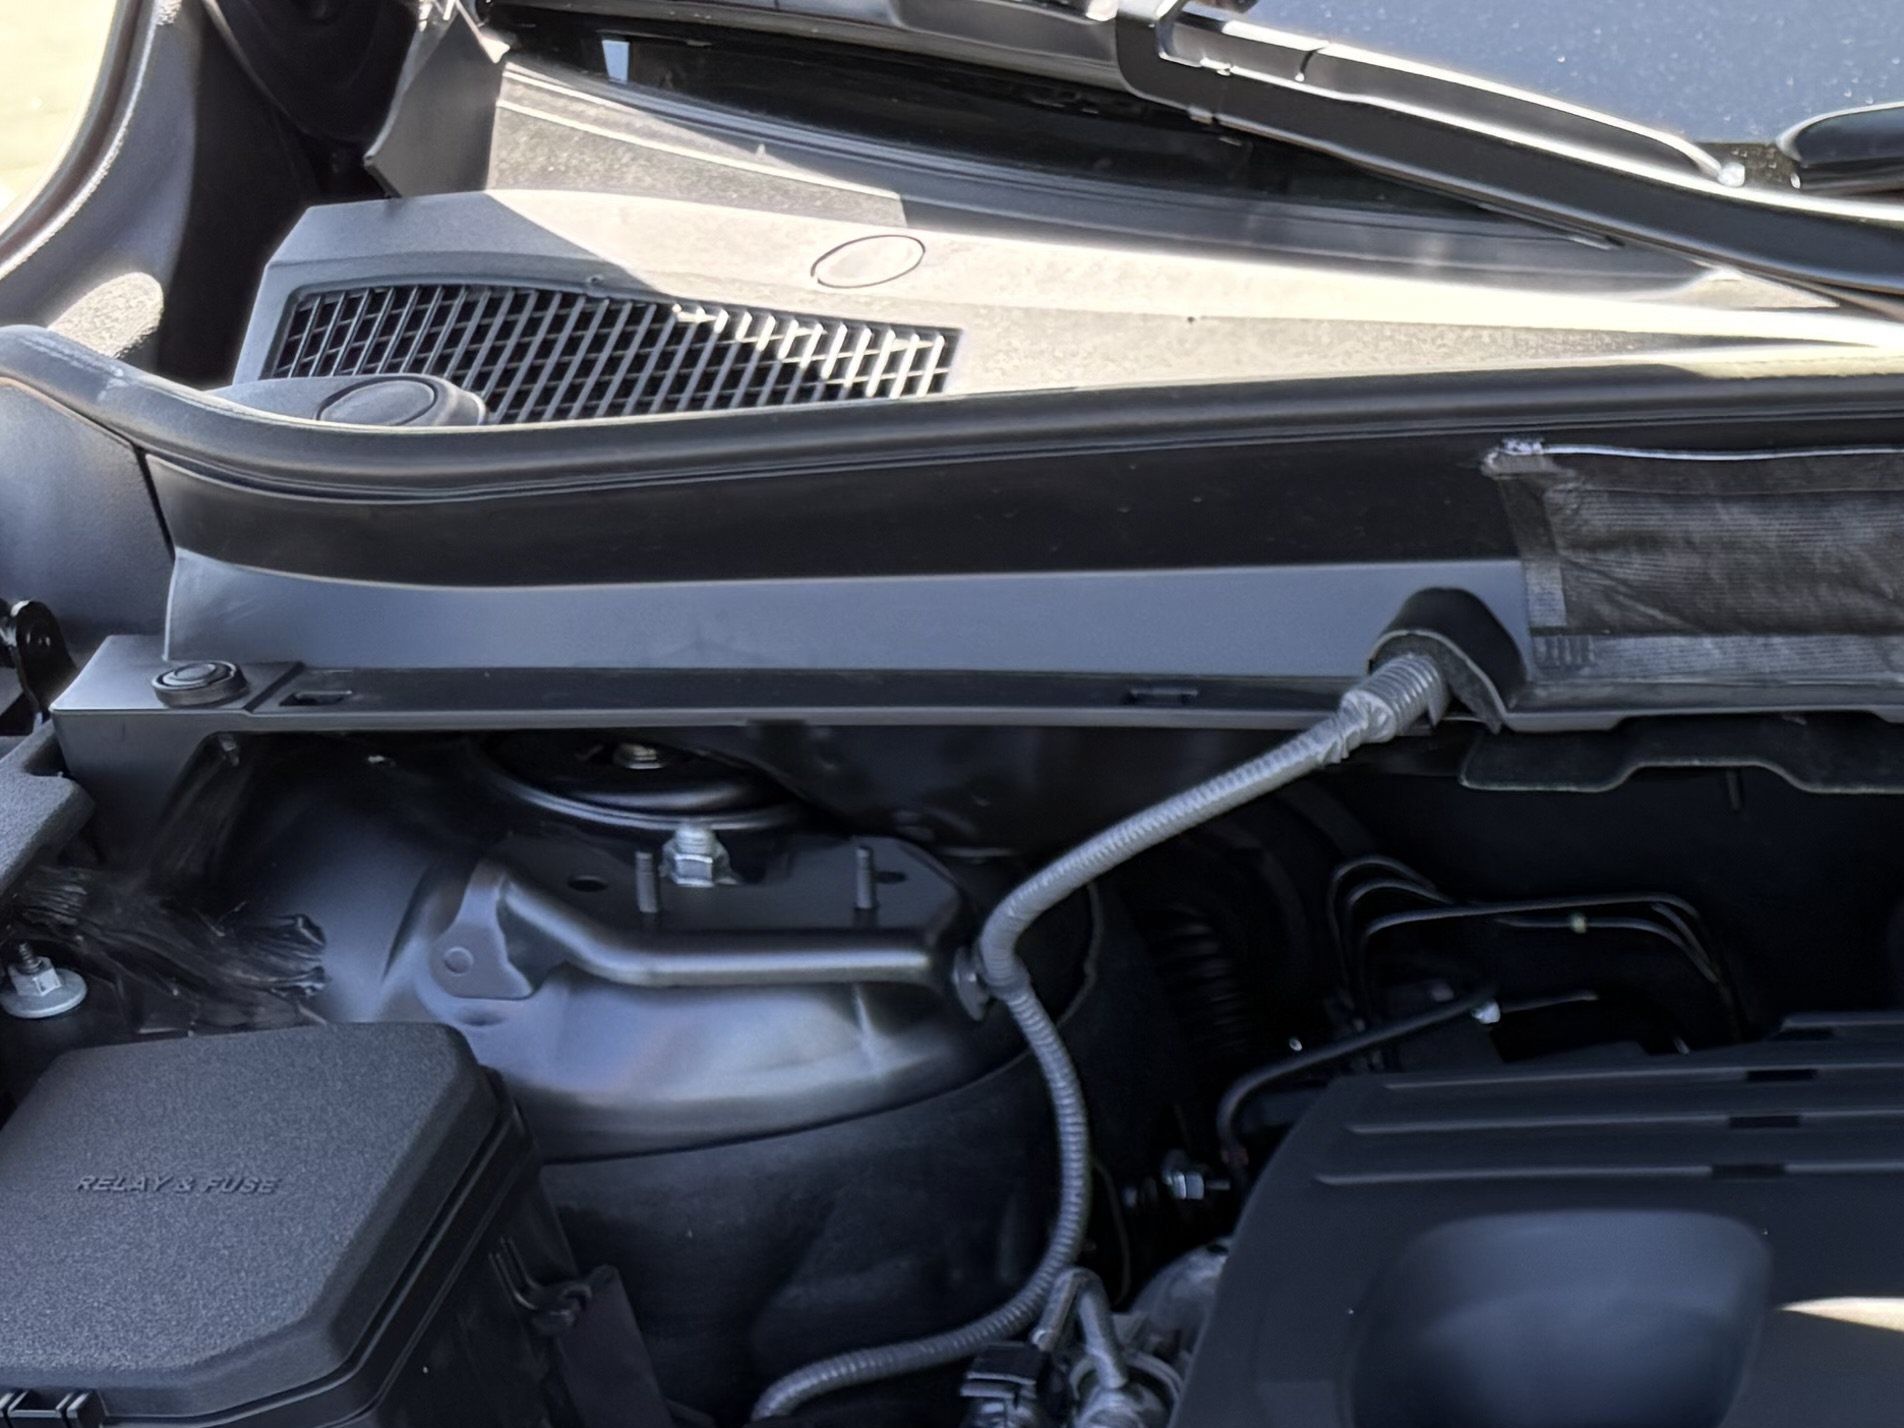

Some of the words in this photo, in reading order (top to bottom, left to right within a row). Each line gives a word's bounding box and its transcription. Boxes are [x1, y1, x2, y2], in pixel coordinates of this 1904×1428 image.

[76, 1175, 173, 1192] RELAY
[174, 1177, 196, 1192] &
[205, 1177, 282, 1194] FUSE
